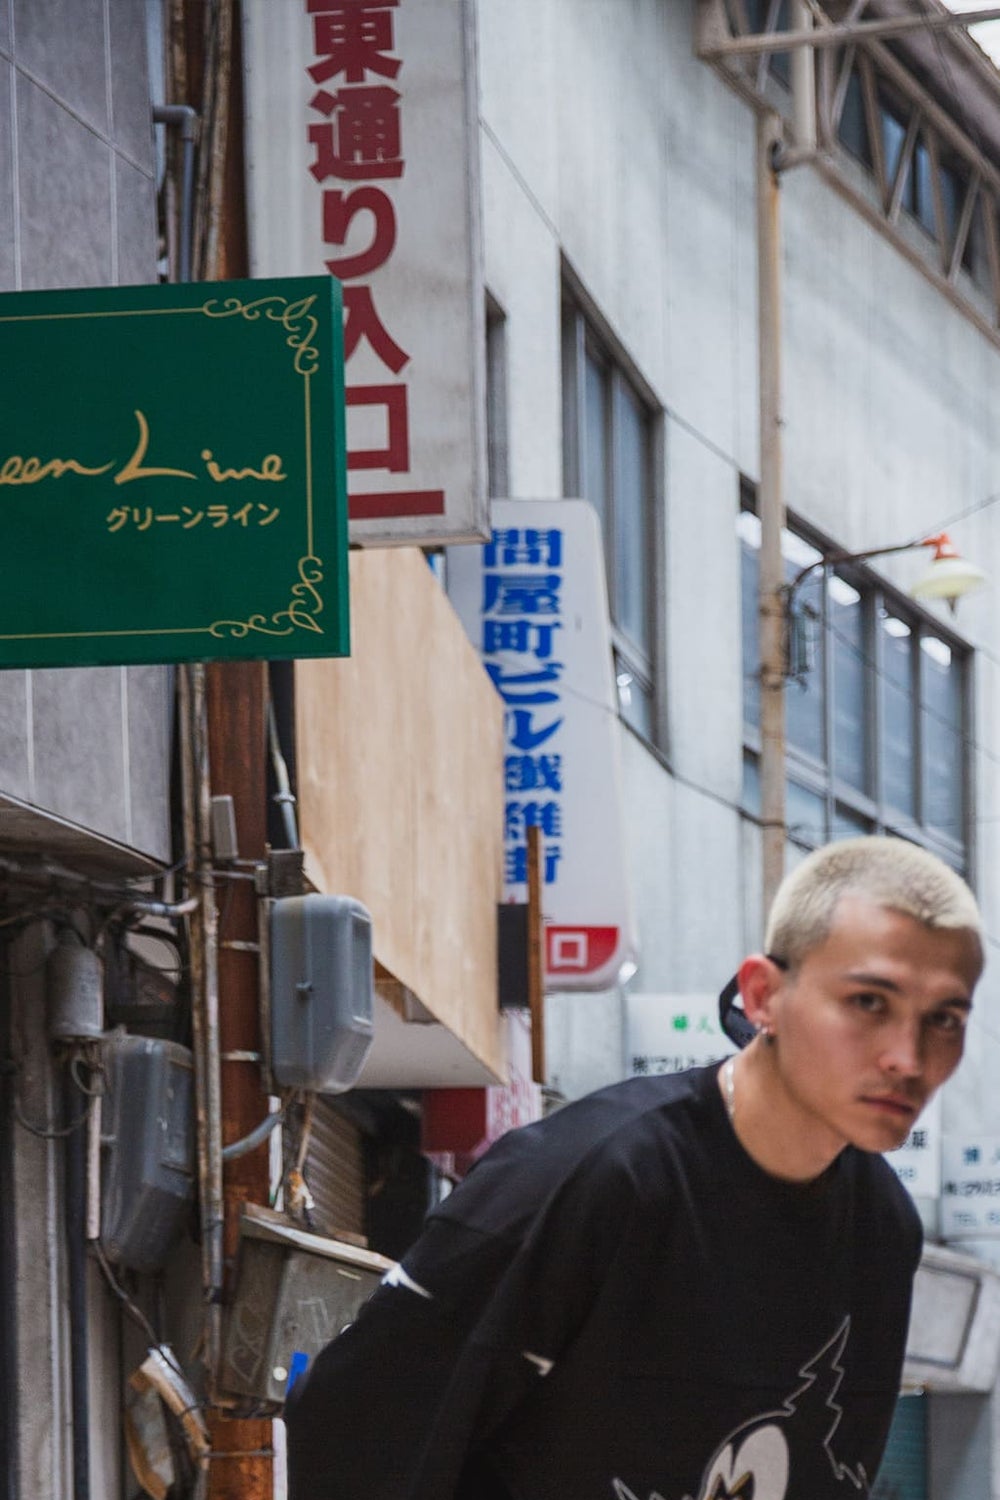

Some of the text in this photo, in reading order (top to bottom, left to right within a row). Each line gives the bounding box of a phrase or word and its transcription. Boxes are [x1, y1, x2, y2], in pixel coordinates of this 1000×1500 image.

[306, 0, 411, 474] 東通り入口
[113, 409, 288, 486] Line
[106, 502, 280, 533] グリーンライン
